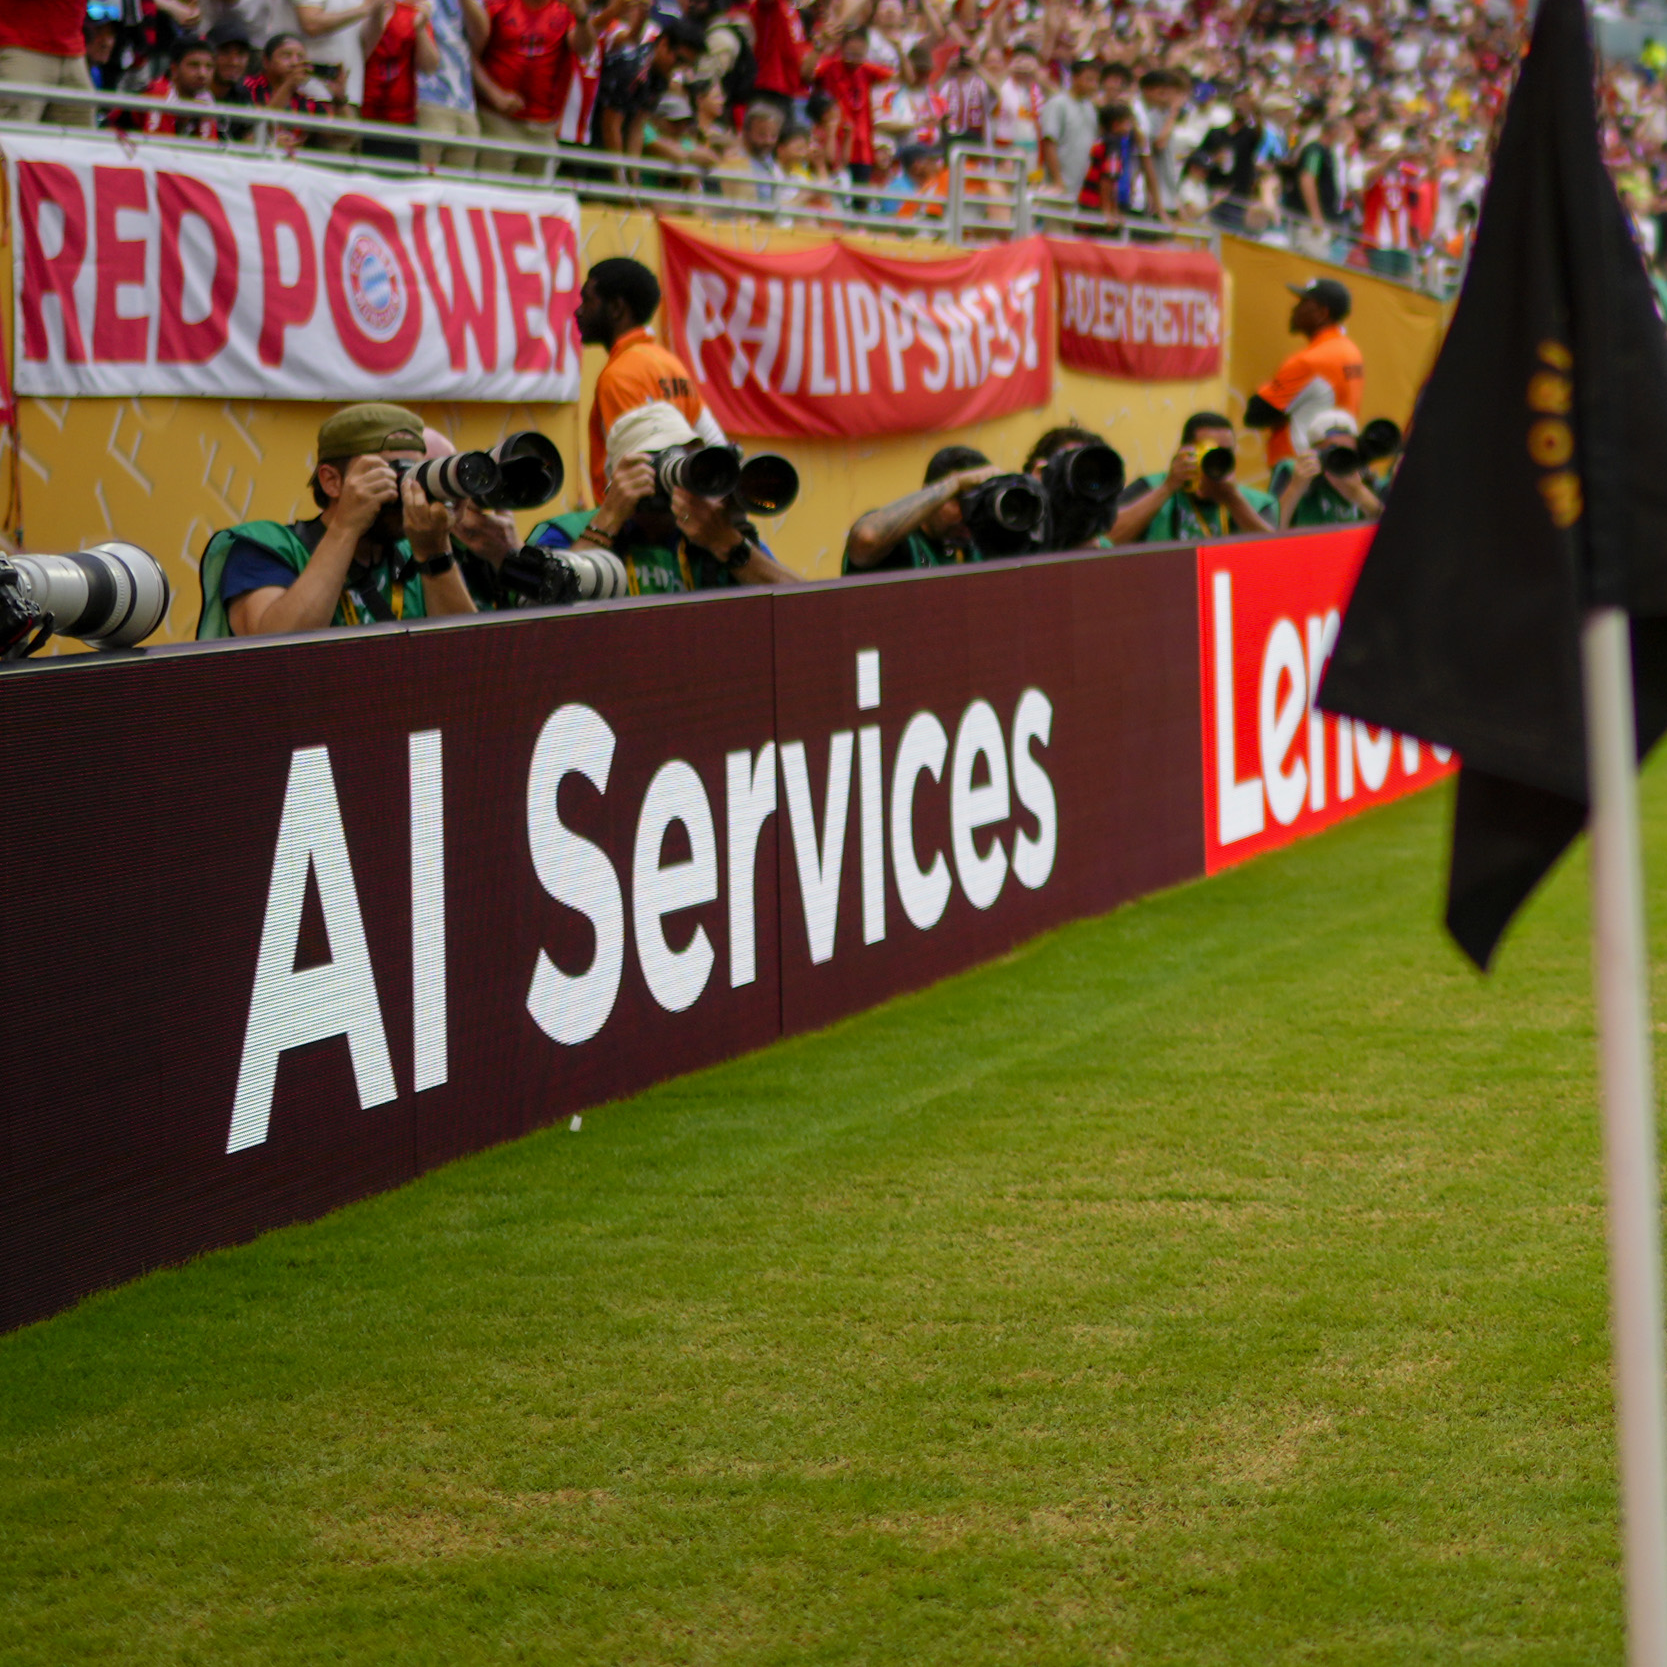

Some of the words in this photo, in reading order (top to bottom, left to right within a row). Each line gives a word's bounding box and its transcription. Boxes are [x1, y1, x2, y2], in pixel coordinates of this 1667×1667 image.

[16, 159, 239, 365] RED
[248, 183, 583, 376] POWER
[225, 727, 449, 1156] AI
[525, 647, 1058, 1048] Services
